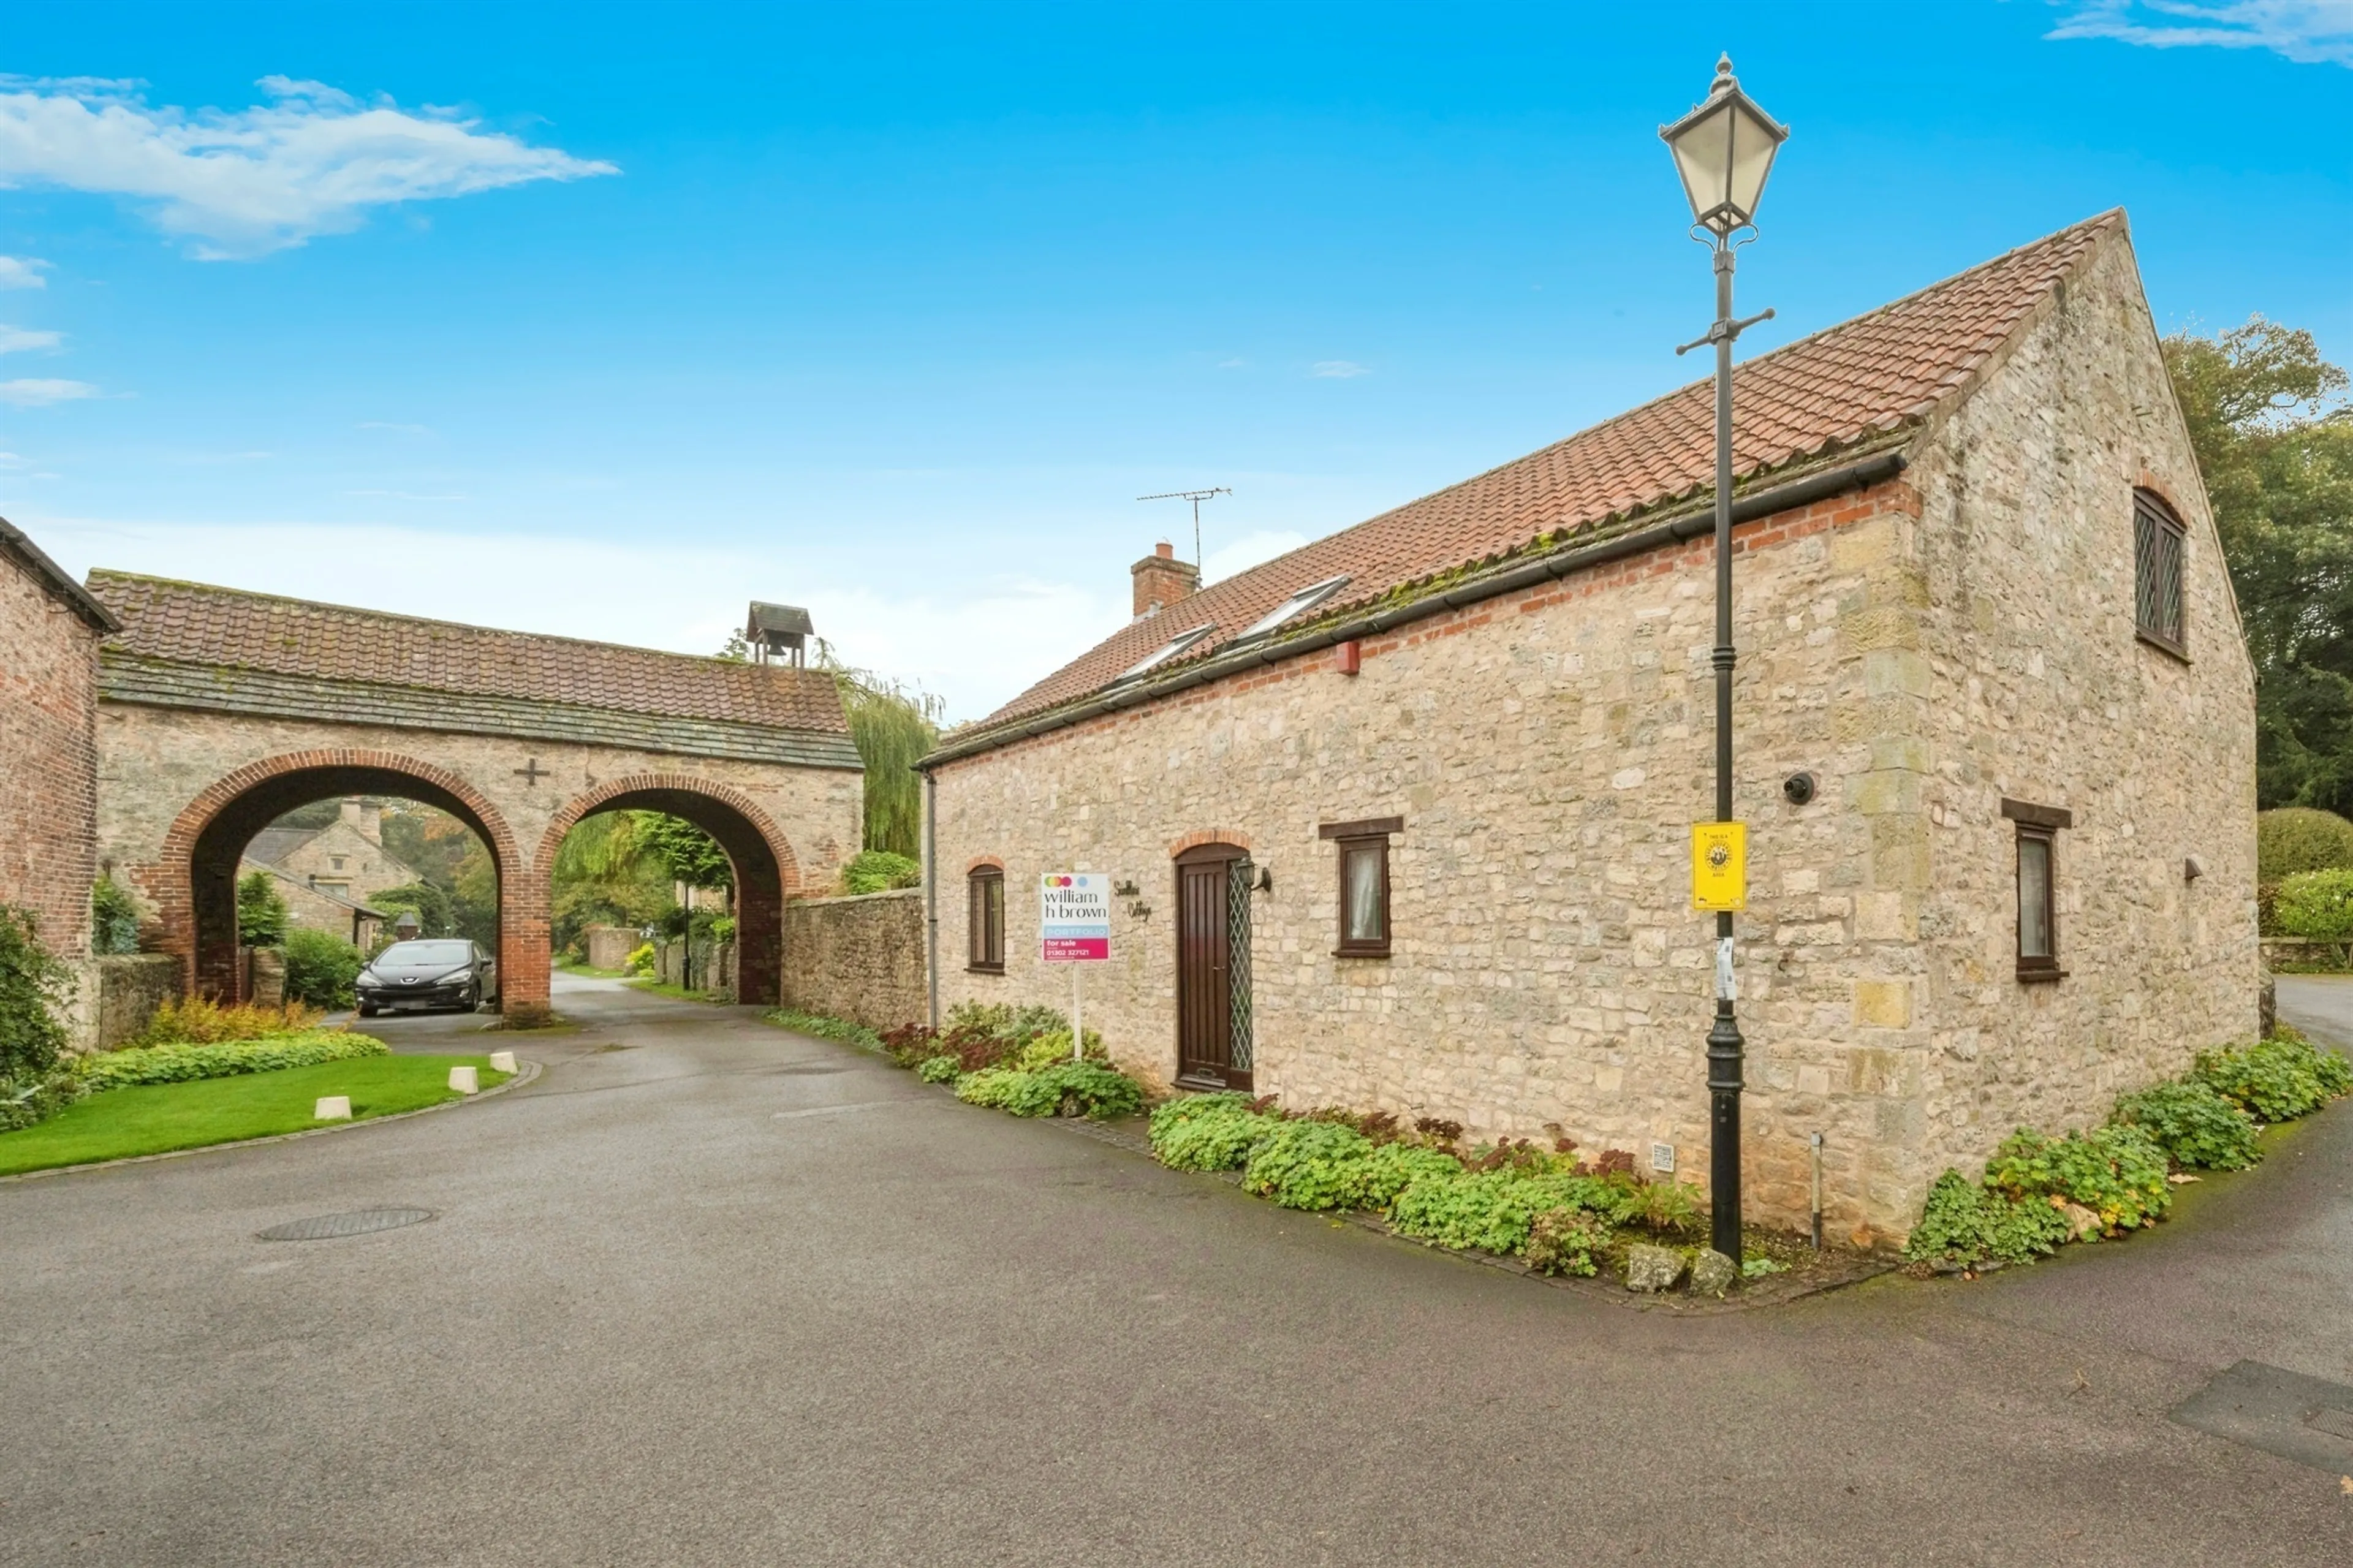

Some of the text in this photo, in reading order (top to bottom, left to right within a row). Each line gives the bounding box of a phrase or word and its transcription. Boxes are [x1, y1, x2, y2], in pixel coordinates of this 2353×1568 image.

[1044, 890, 1098, 903] william
[1046, 904, 1107, 918] h brown
